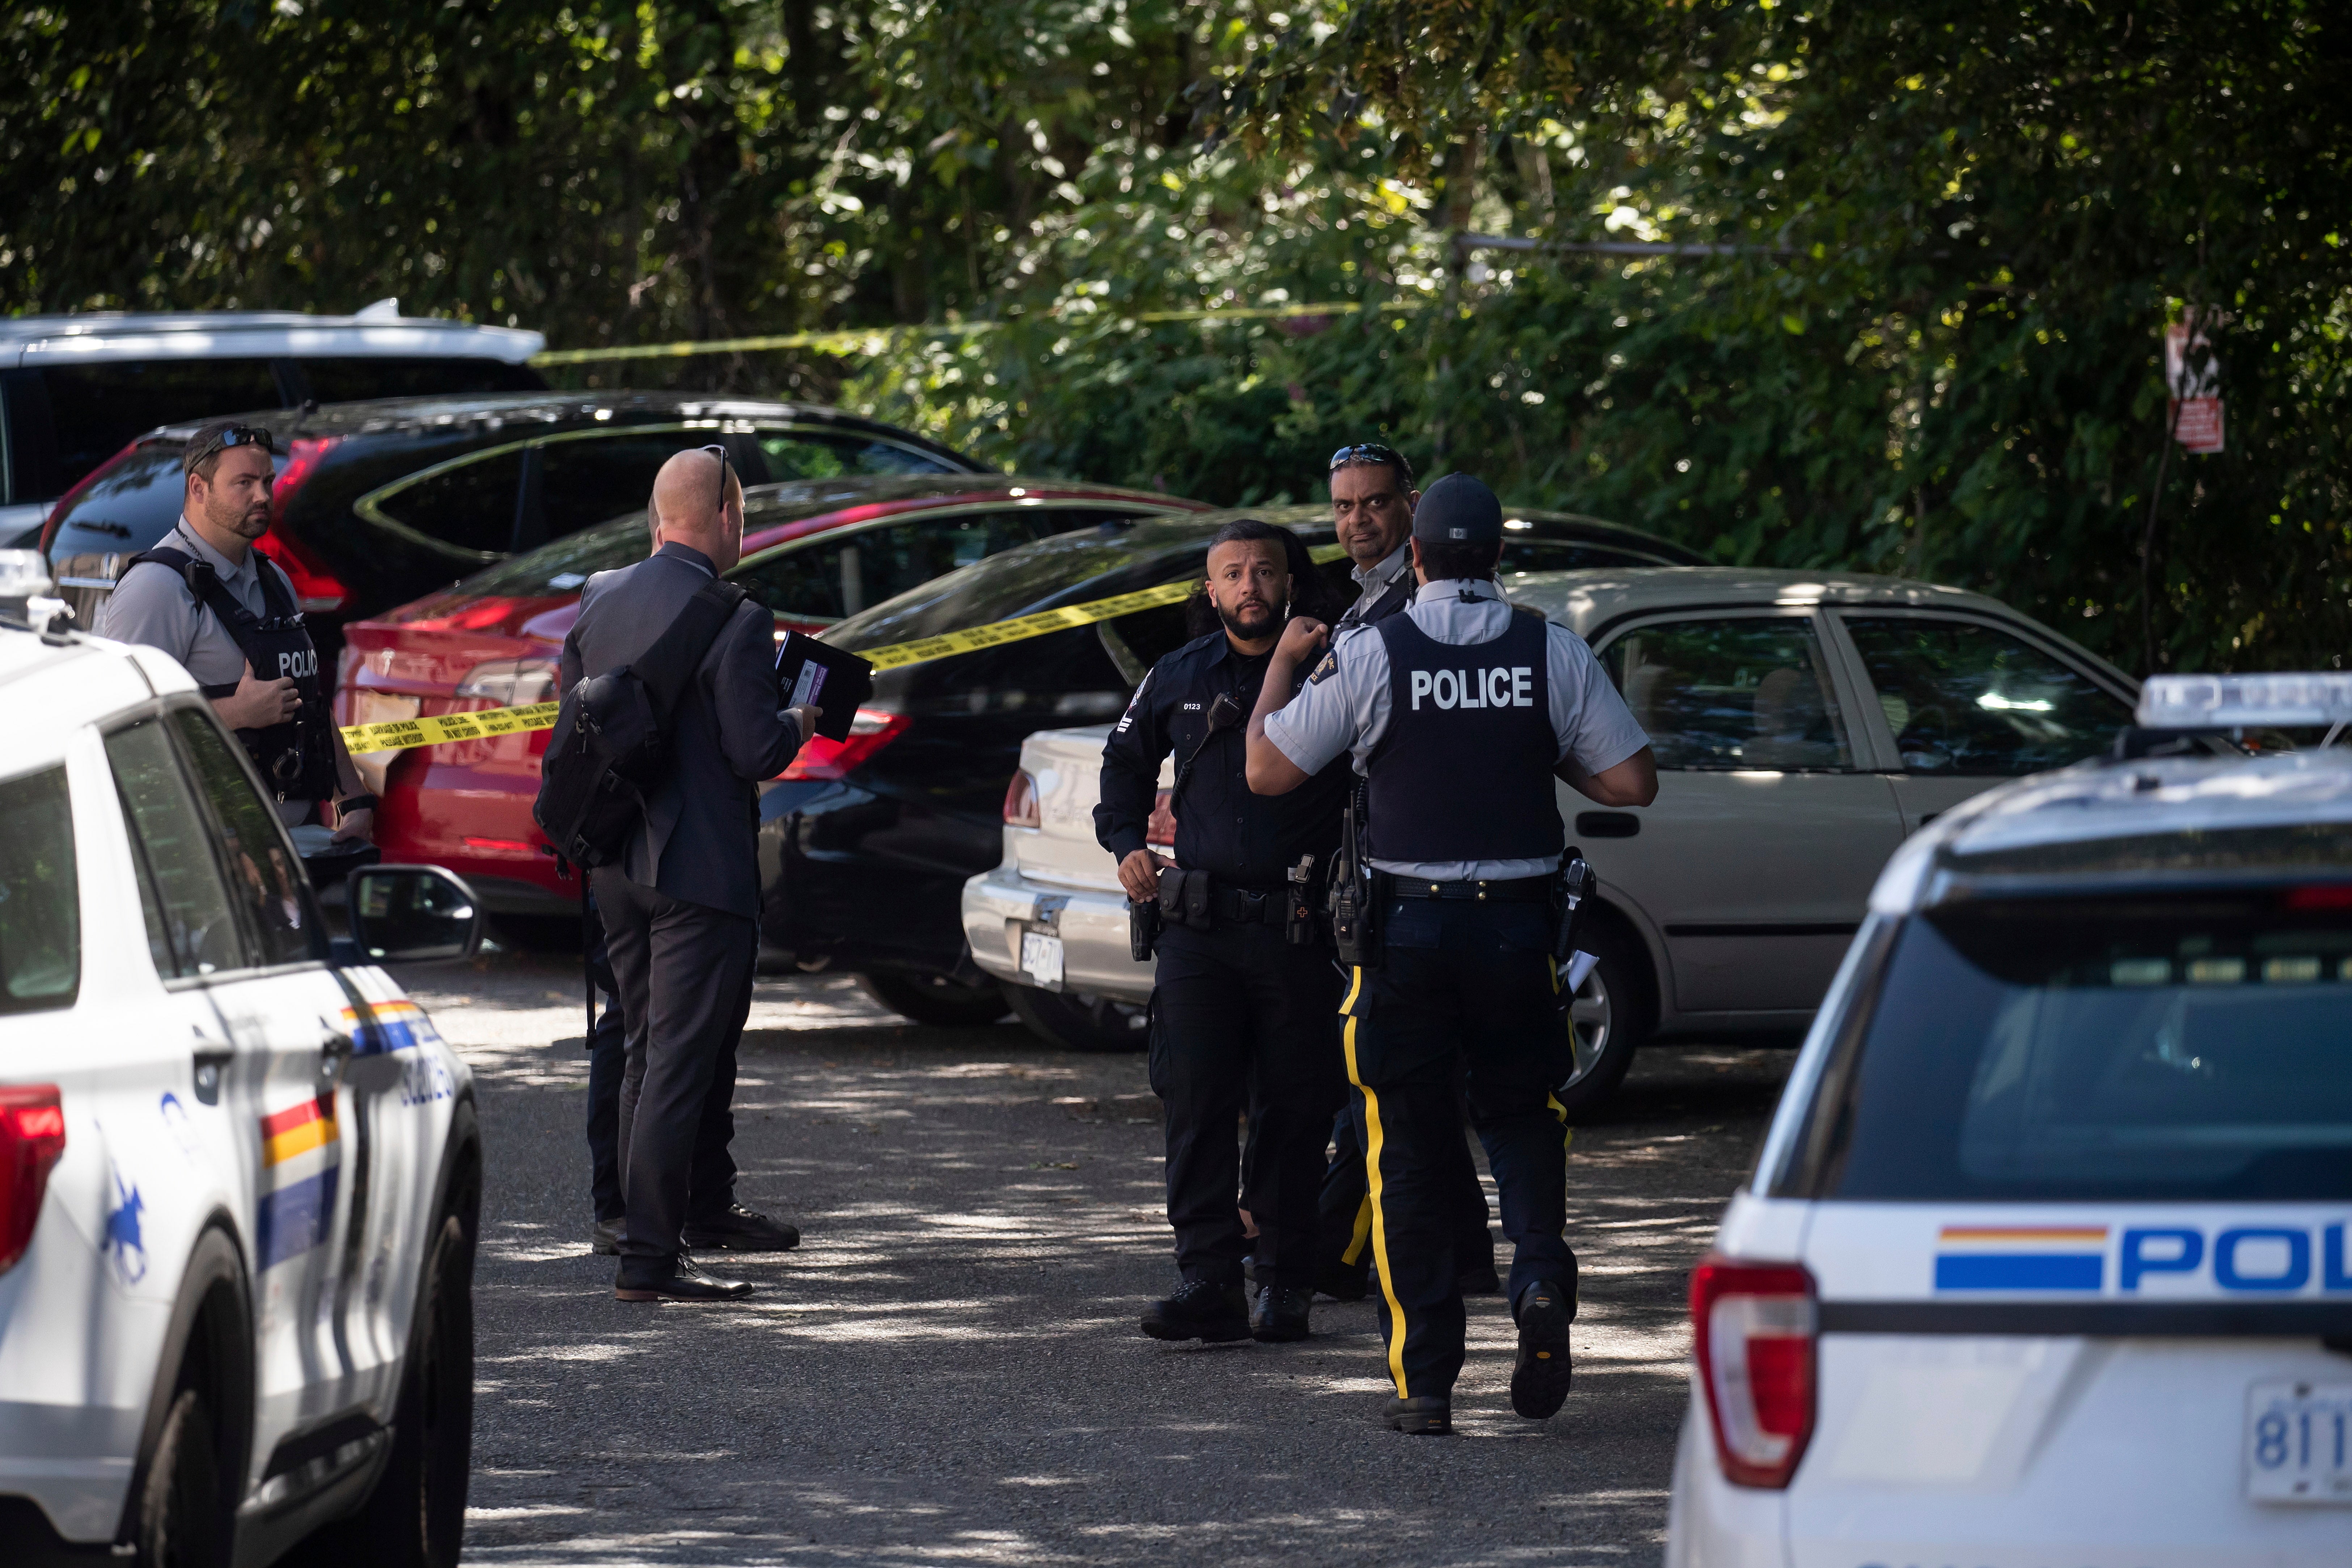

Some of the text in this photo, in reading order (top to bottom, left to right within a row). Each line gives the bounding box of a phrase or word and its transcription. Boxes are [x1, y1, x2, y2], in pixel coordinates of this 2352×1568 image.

[279, 649, 317, 678] POLIC
[1411, 667, 1532, 710] POLICE
[2120, 1223, 2352, 1292] POL
[2254, 1411, 2345, 1469] 811
